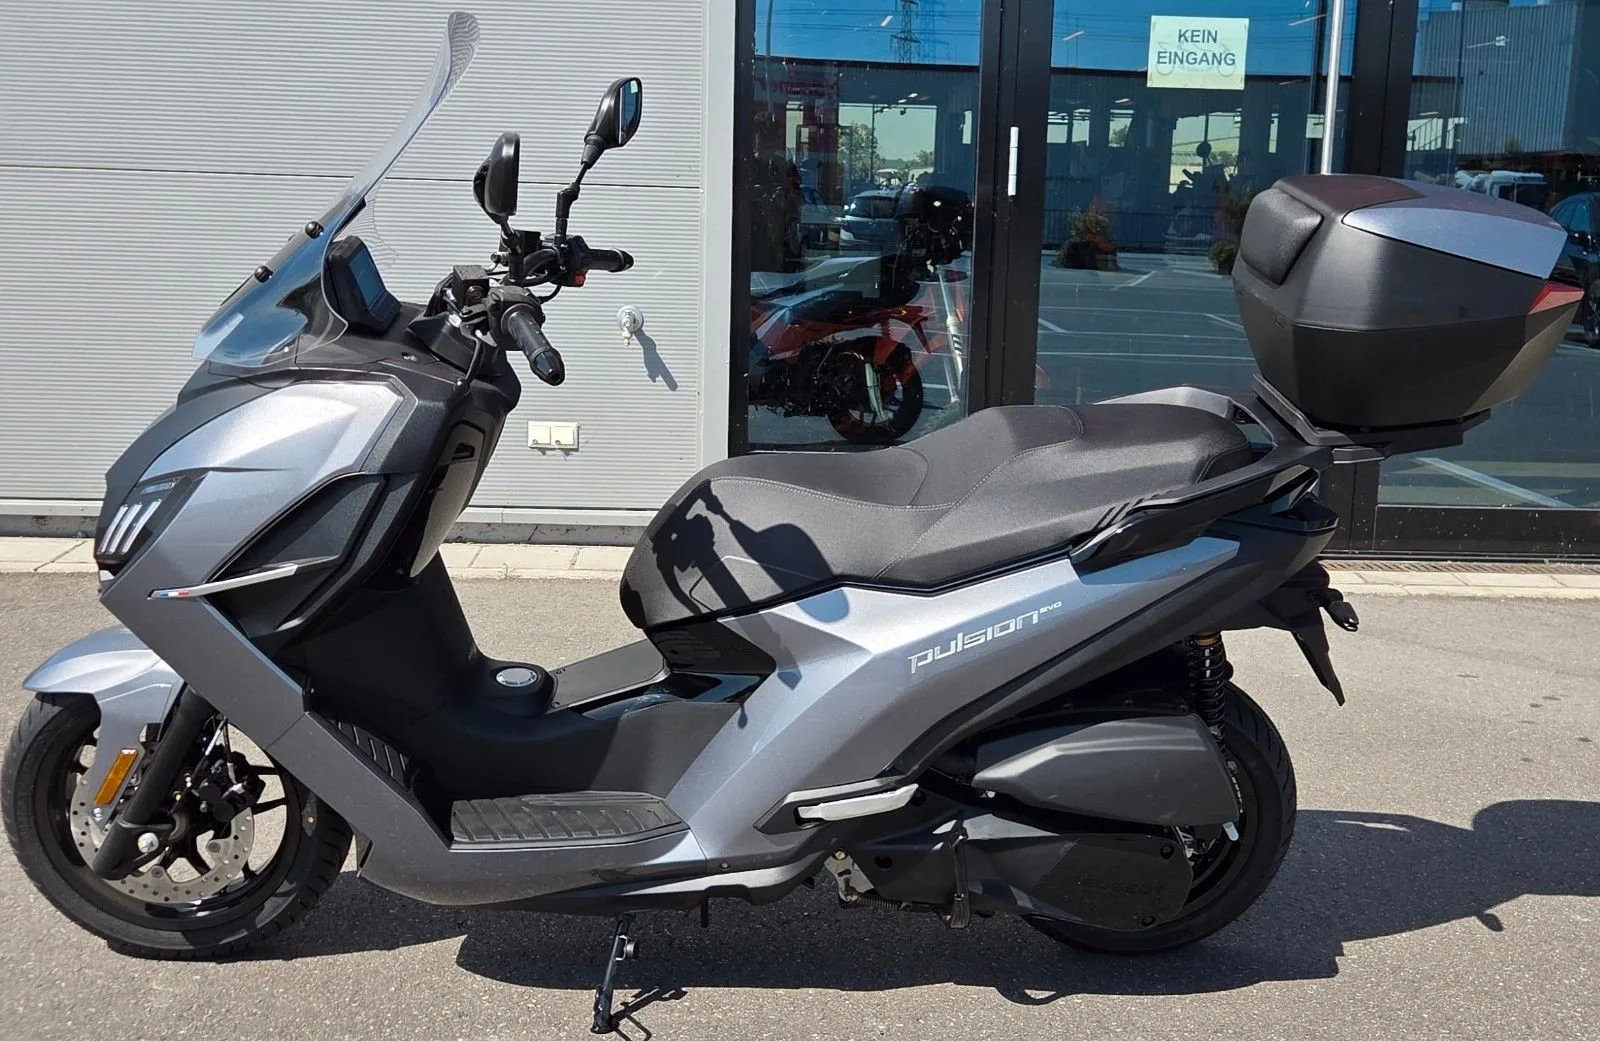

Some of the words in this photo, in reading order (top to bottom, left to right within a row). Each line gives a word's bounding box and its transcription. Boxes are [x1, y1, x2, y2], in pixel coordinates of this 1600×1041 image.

[1178, 29, 1218, 43] KEIN
[1157, 51, 1236, 66] EINGANG
[907, 610, 1038, 674] pulsion
